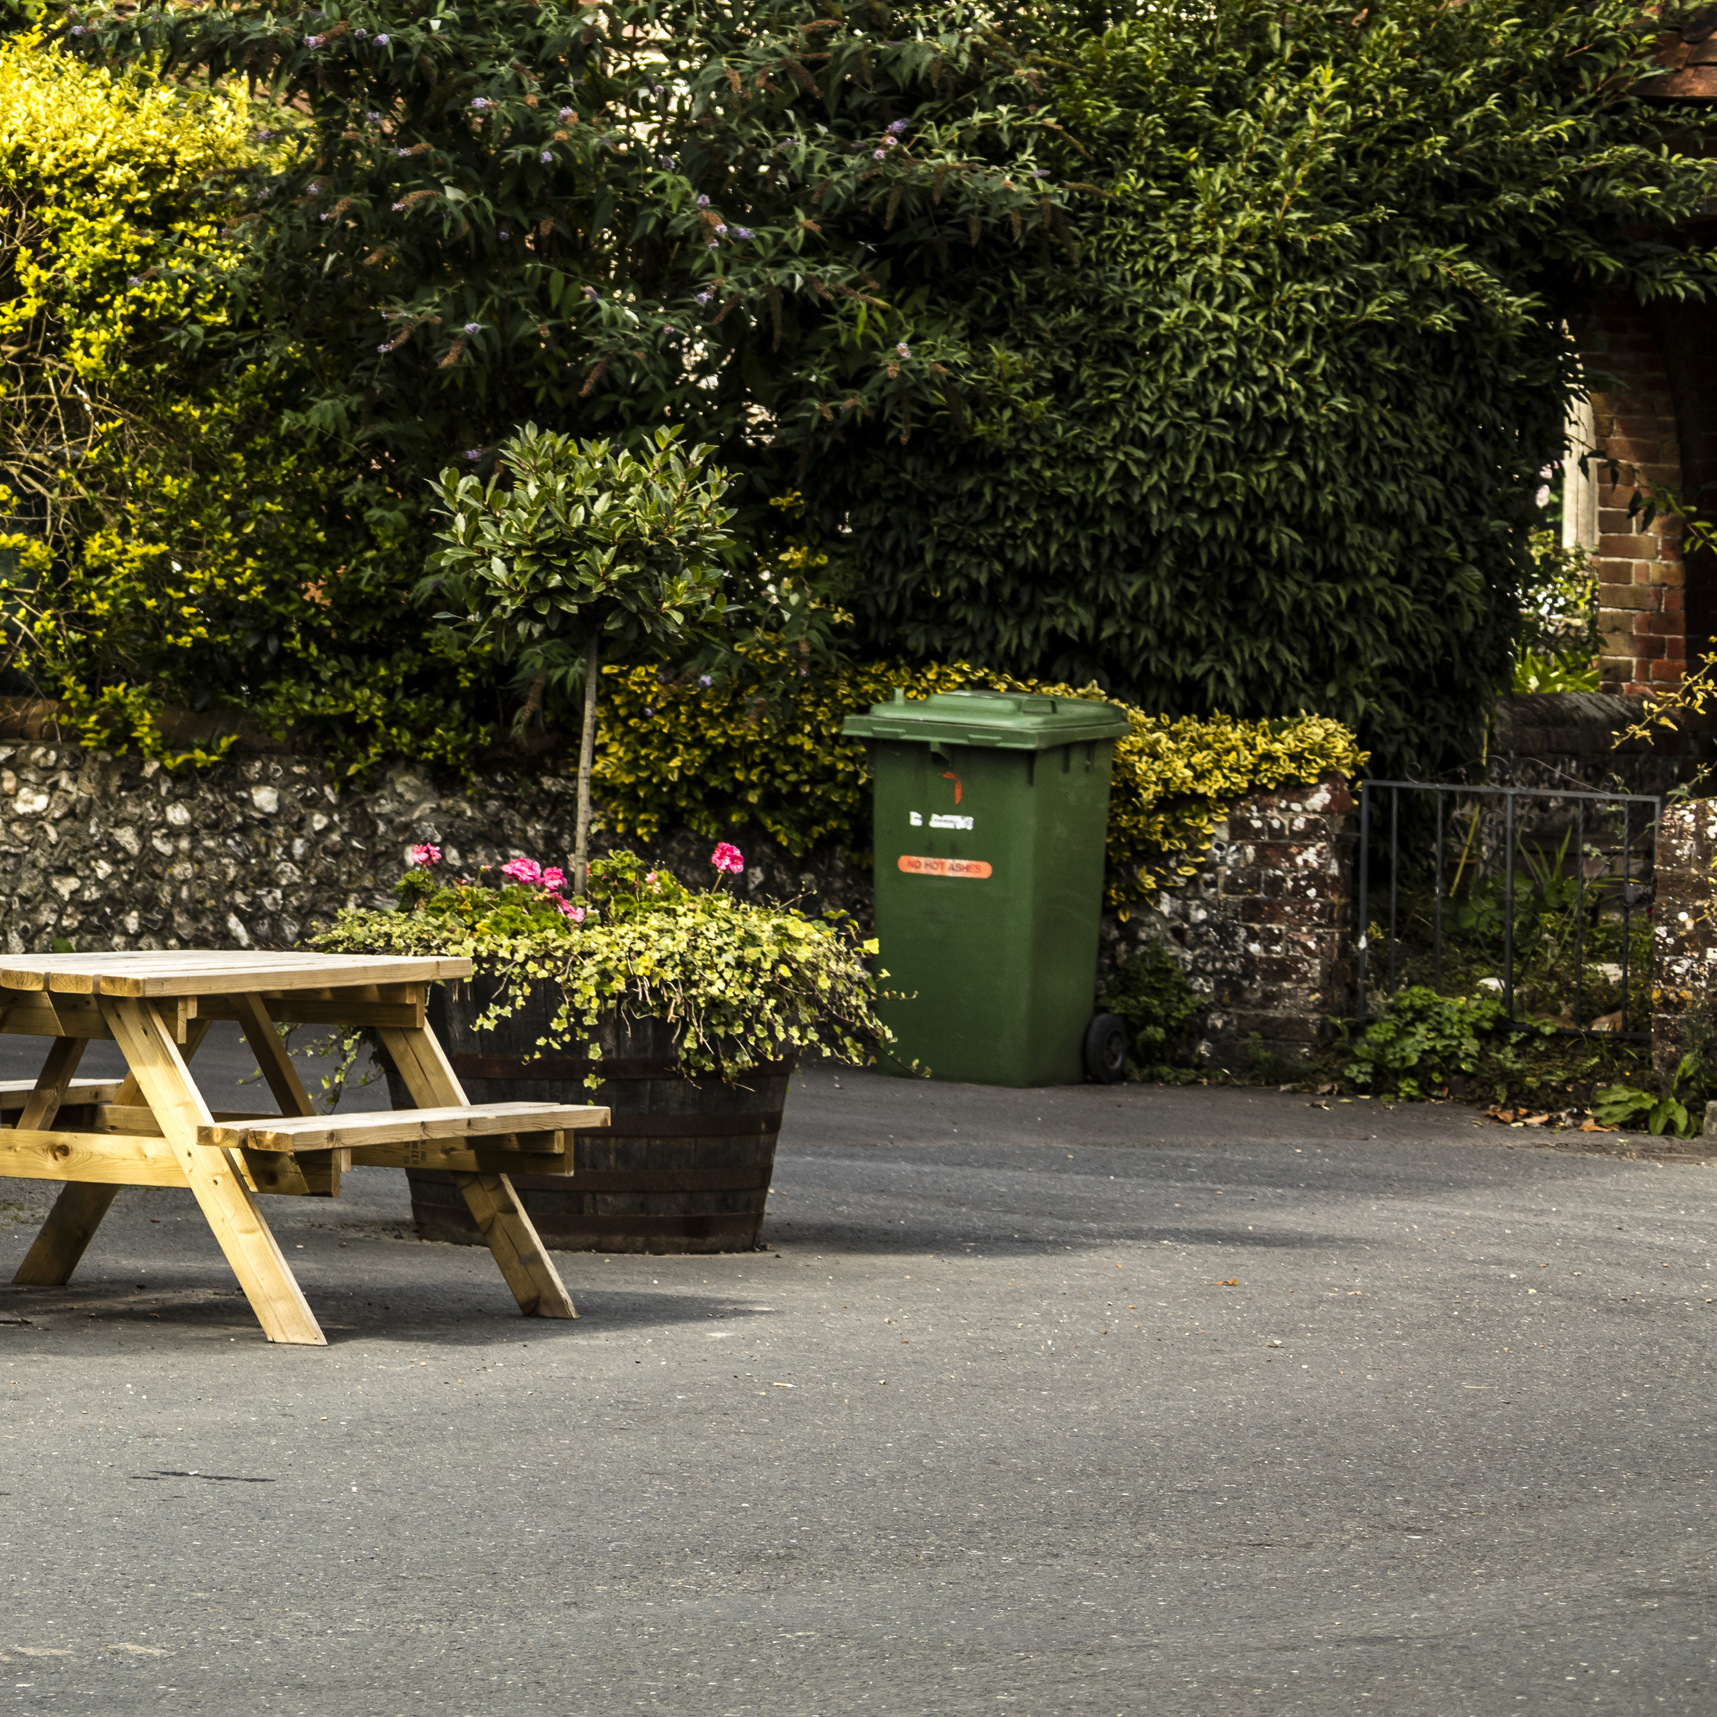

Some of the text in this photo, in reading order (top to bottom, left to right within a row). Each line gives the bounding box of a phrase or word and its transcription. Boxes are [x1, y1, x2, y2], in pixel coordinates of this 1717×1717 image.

[907, 860, 982, 874] NO HOT ASHES
